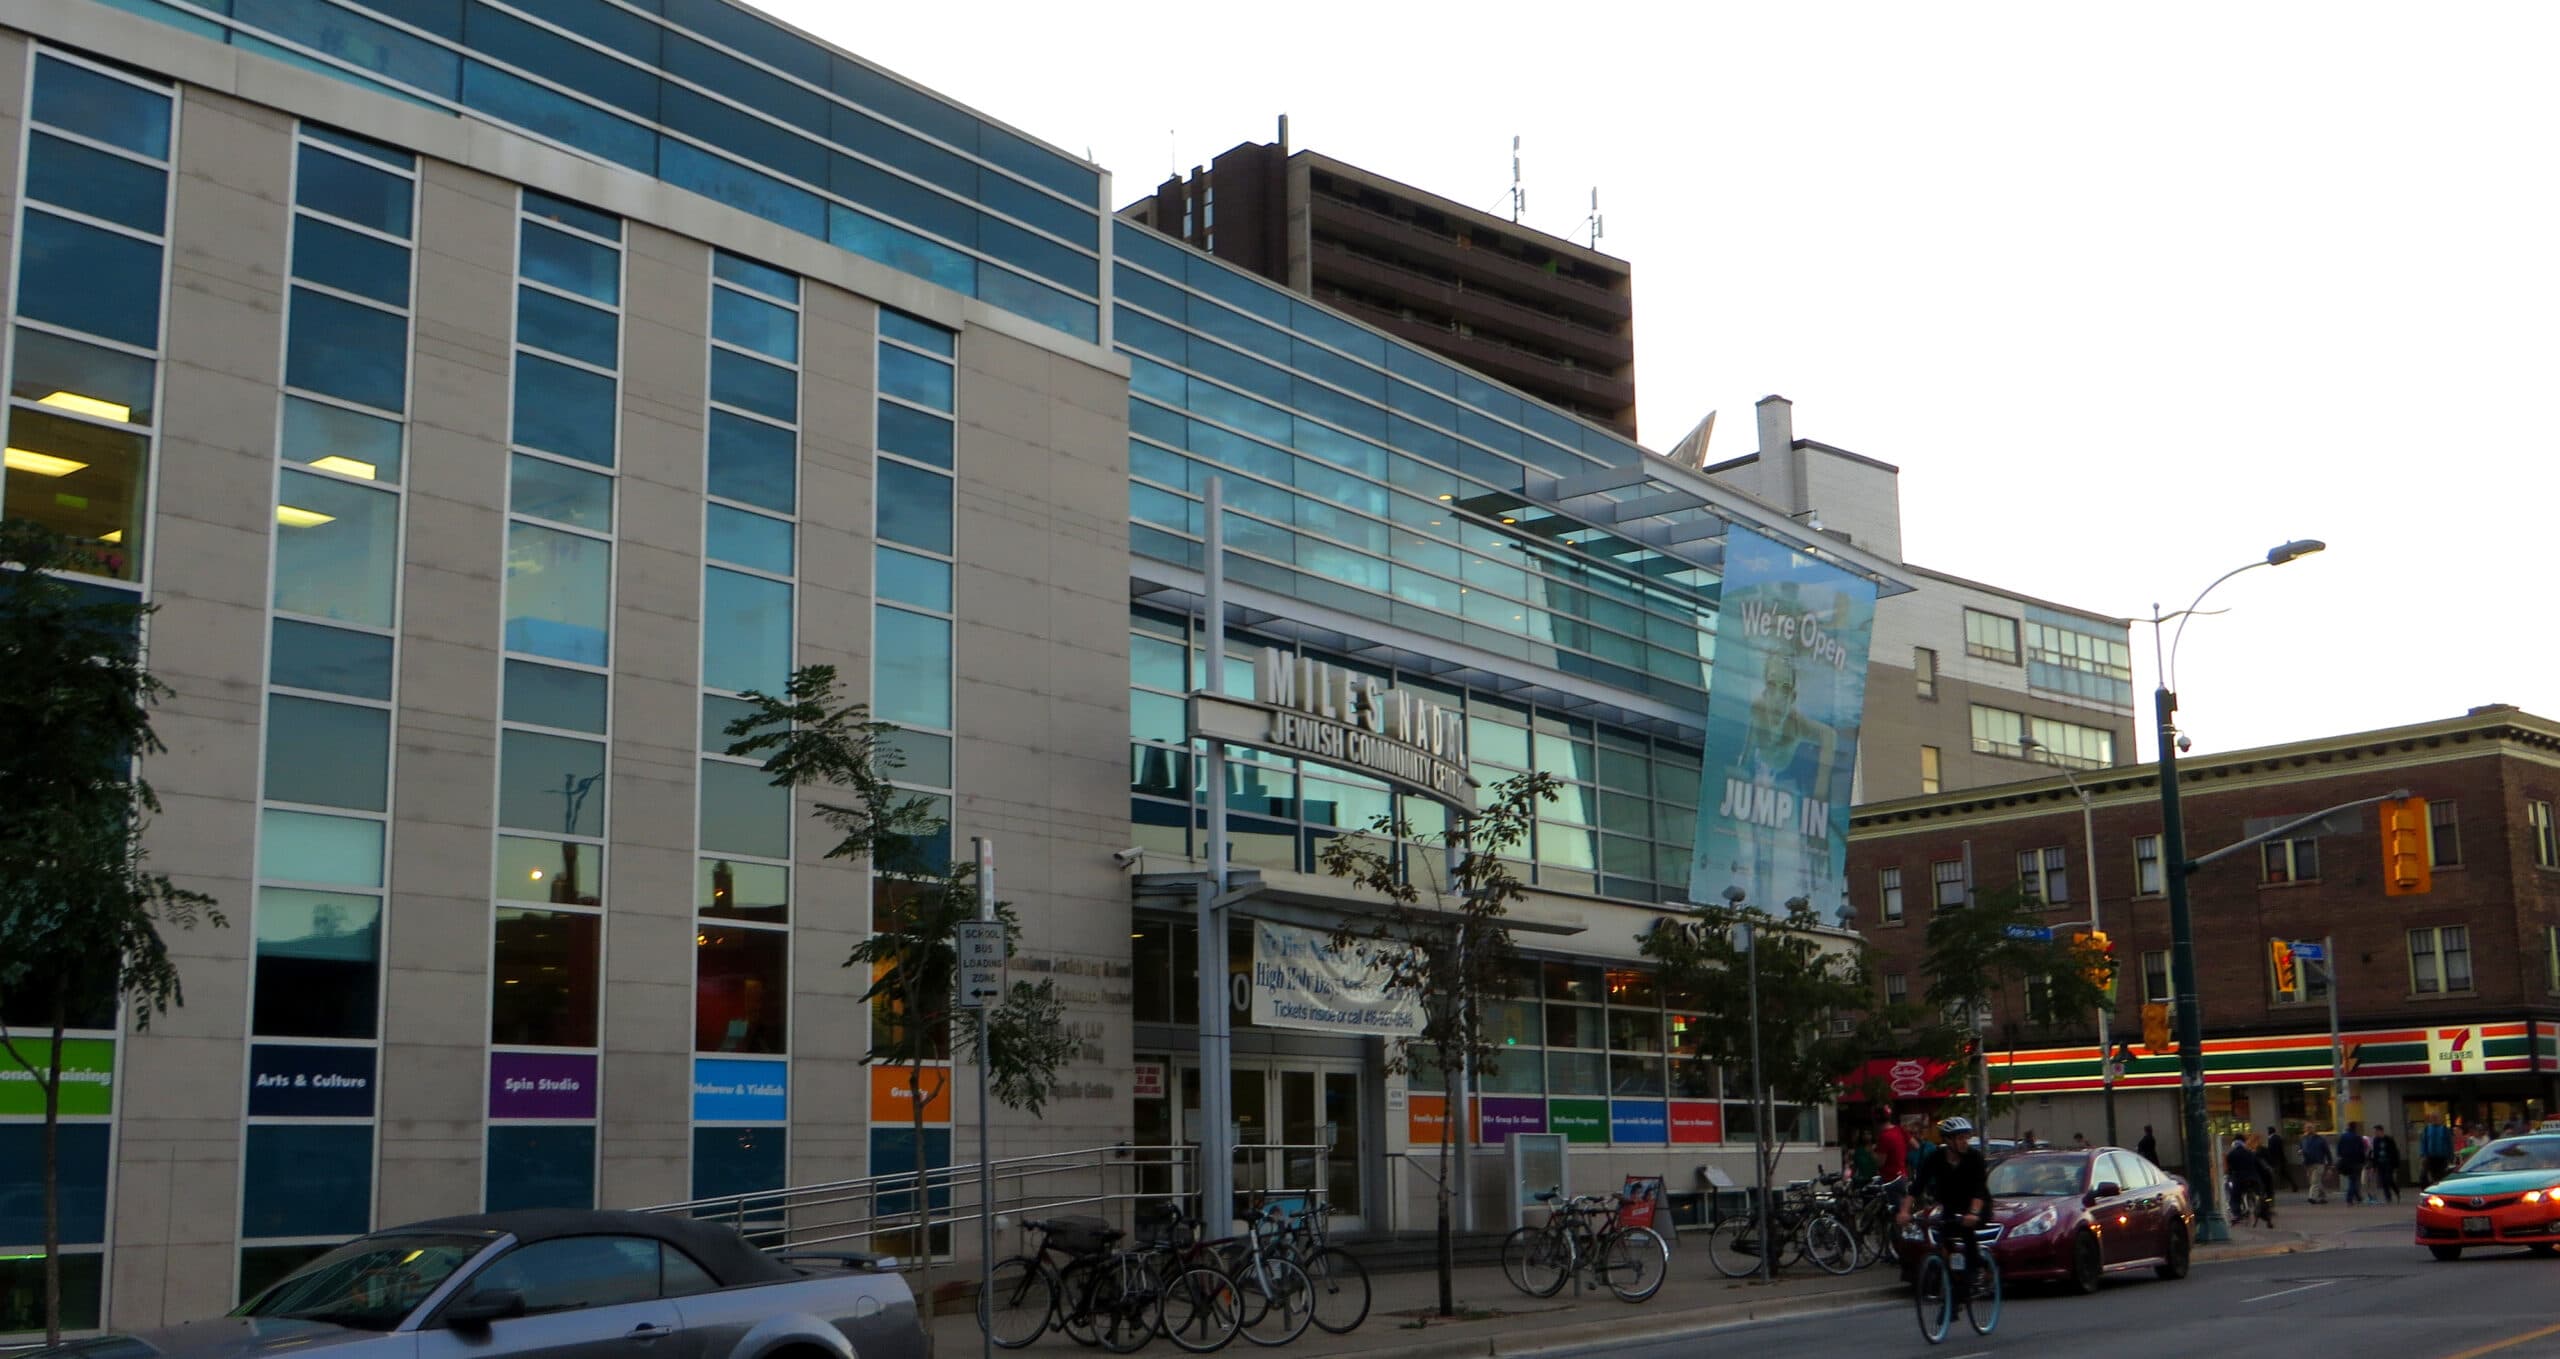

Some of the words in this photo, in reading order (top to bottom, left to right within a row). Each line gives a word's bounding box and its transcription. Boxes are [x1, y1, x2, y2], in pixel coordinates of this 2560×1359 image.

[1741, 602, 1795, 640] We're
[1801, 613, 1847, 672] Open
[1262, 646, 1380, 734] MILES
[1270, 709, 1344, 759] JEWISH
[1346, 730, 1431, 786] COMMUNITY
[1720, 778, 1793, 829] JUMP
[1801, 798, 1829, 840] IN
[965, 928, 1001, 938] SCHOOL
[974, 943, 993, 953] BUS
[963, 959, 1003, 969] LOADING
[971, 974, 997, 983] ZONE
[1256, 962, 1285, 994] High
[1274, 1000, 1307, 1021] Tickets
[1347, 1010, 1363, 1026] call
[44, 1067, 112, 1087] Taining
[256, 1073, 289, 1087] Arts
[294, 1073, 307, 1087] &
[312, 1074, 367, 1088] Culture
[505, 1077, 534, 1093] Spin
[538, 1078, 580, 1091] Studio
